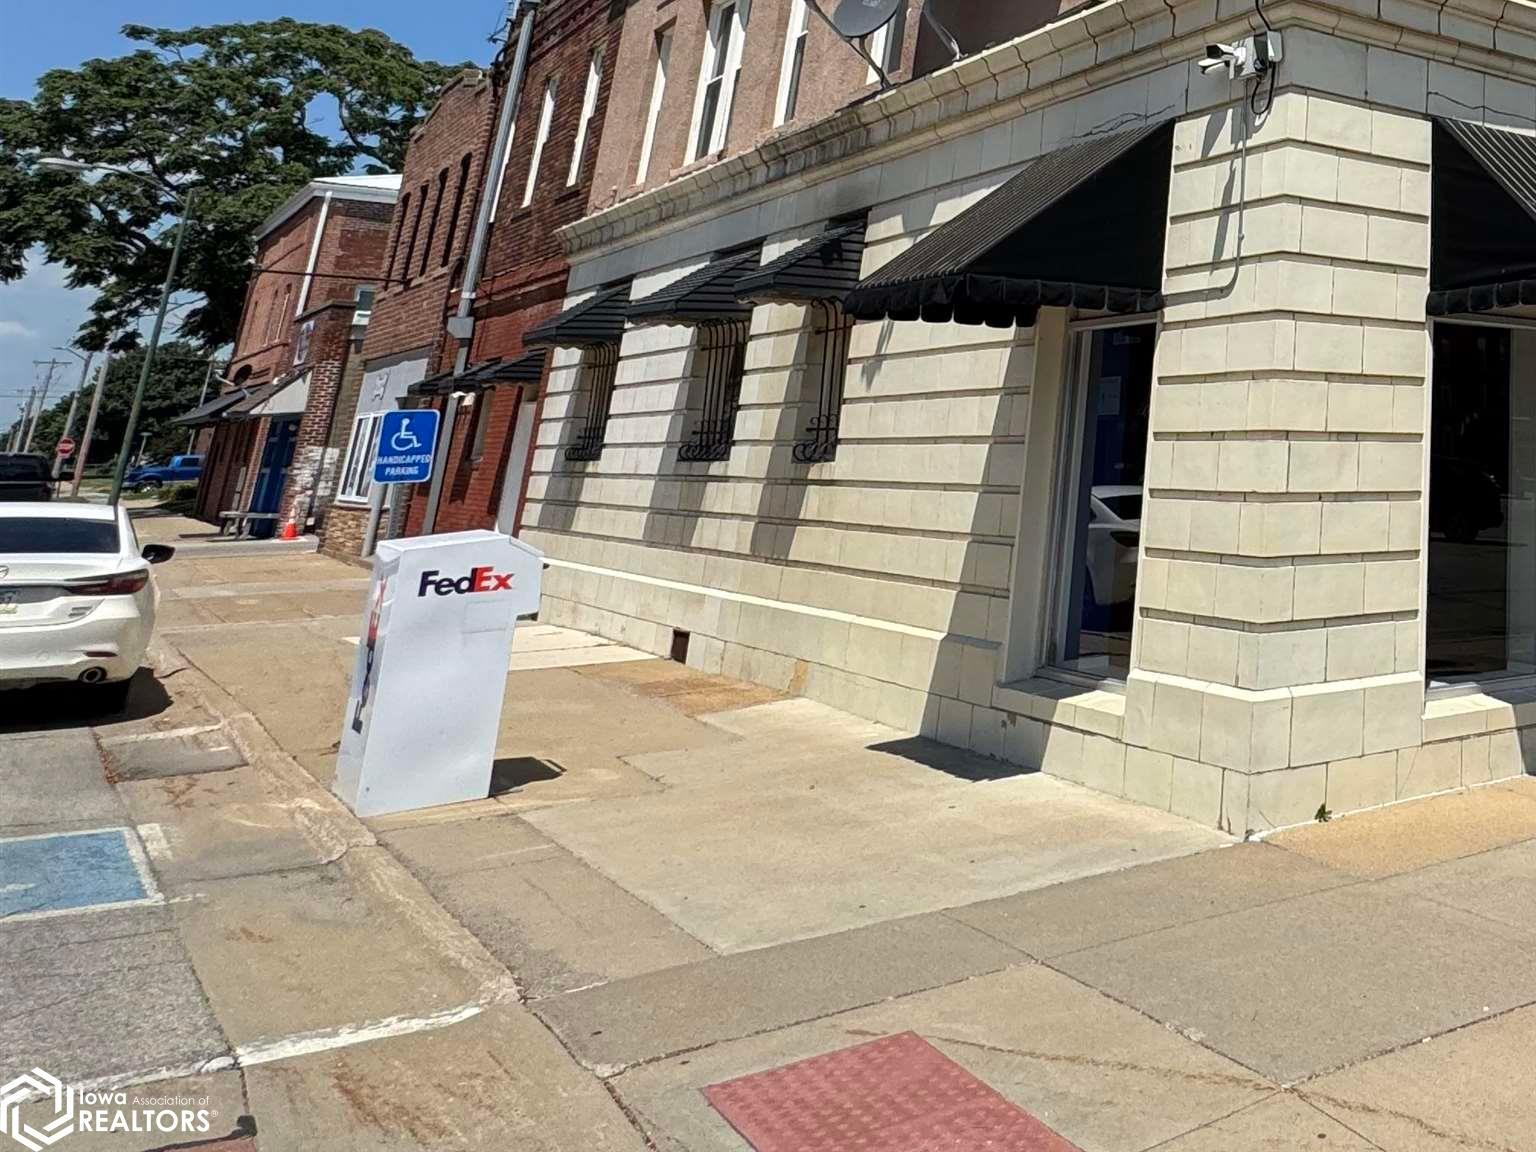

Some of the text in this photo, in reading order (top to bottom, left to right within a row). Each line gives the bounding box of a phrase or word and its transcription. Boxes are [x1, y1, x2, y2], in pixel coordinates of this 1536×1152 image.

[376, 454, 431, 465] HANDICAPPED
[385, 466, 419, 476] PARKING
[417, 566, 515, 597] FedEx
